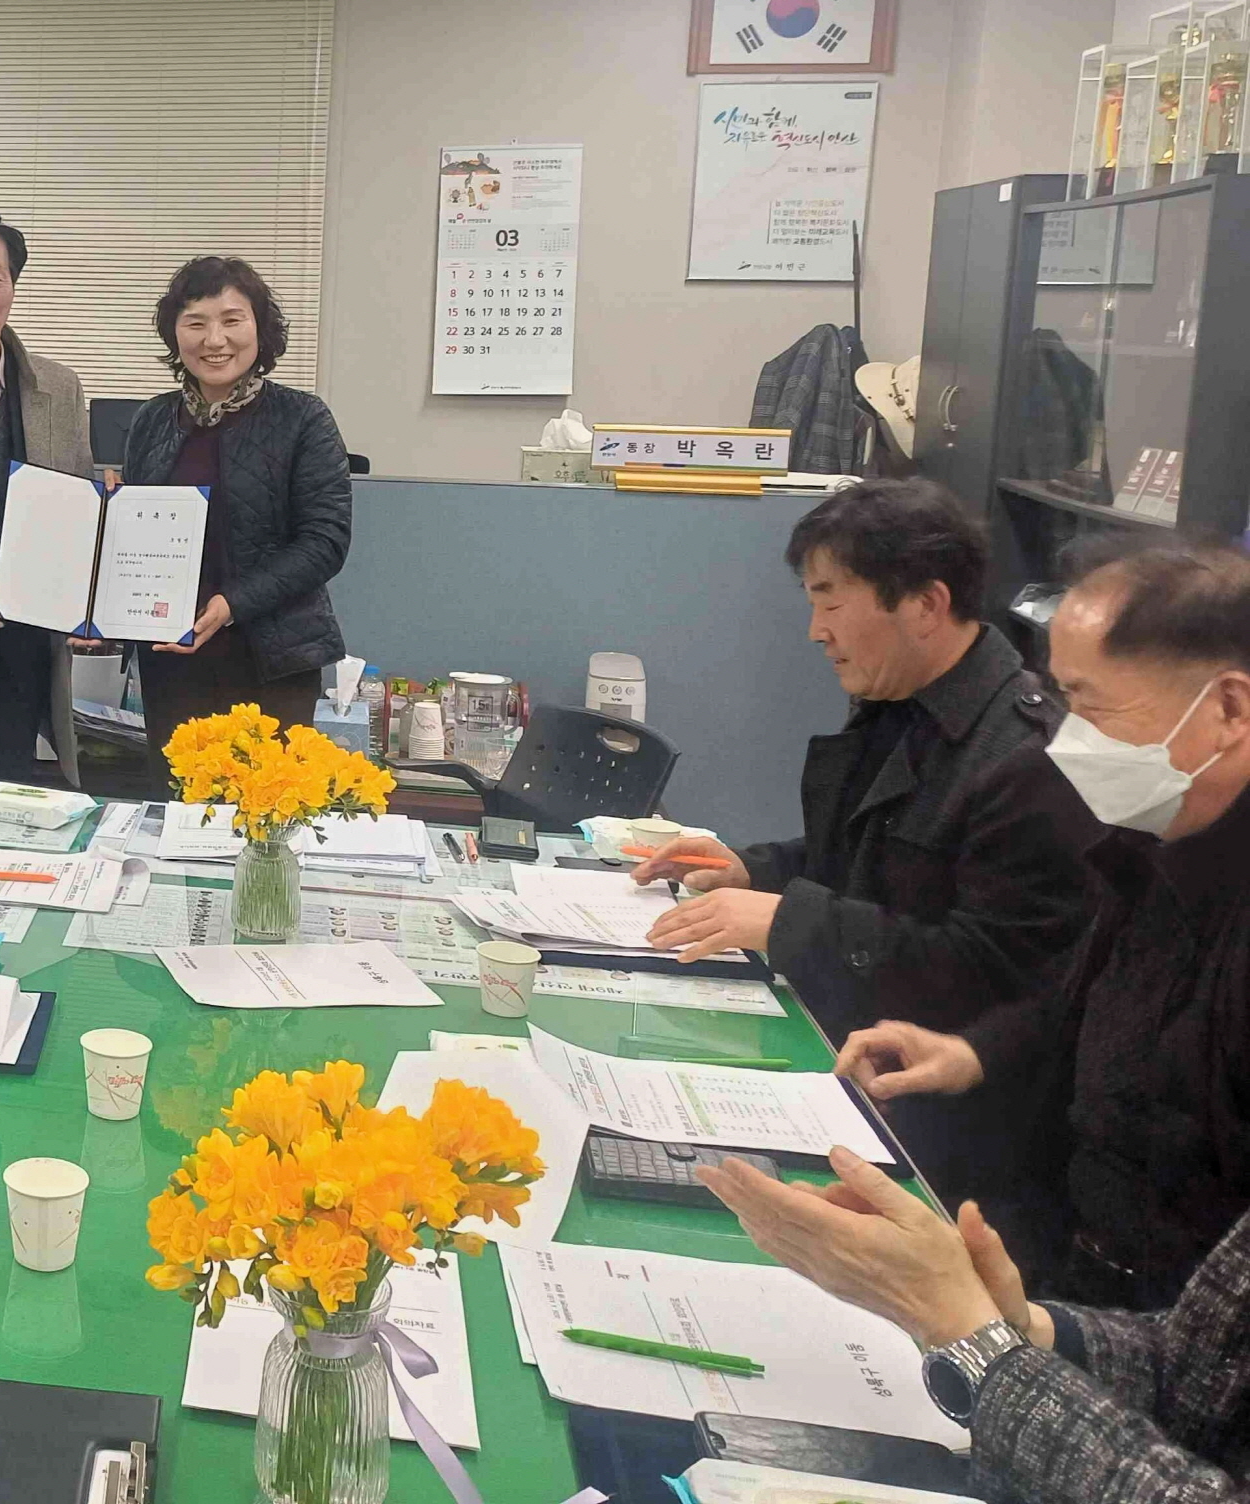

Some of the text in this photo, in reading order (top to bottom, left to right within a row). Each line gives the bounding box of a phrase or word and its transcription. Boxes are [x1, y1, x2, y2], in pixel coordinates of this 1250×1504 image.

[827, 132, 860, 146] 안산
[495, 229, 519, 247] 03
[452, 270, 562, 279] 1 2 3 4 5 6 7
[450, 289, 564, 298] 8 9 10 11 12 13 14
[448, 308, 562, 317] 15 16 17 18 19 20 21
[446, 327, 563, 336] 22 23 24 25 26 27 28
[445, 345, 491, 355] 29 30 31
[626, 439, 775, 461] 동장 박옥란
[532, 981, 573, 991] 안산
[577, 984, 624, 996] 제9대
[844, 1342, 893, 1399] 상록구 이동
